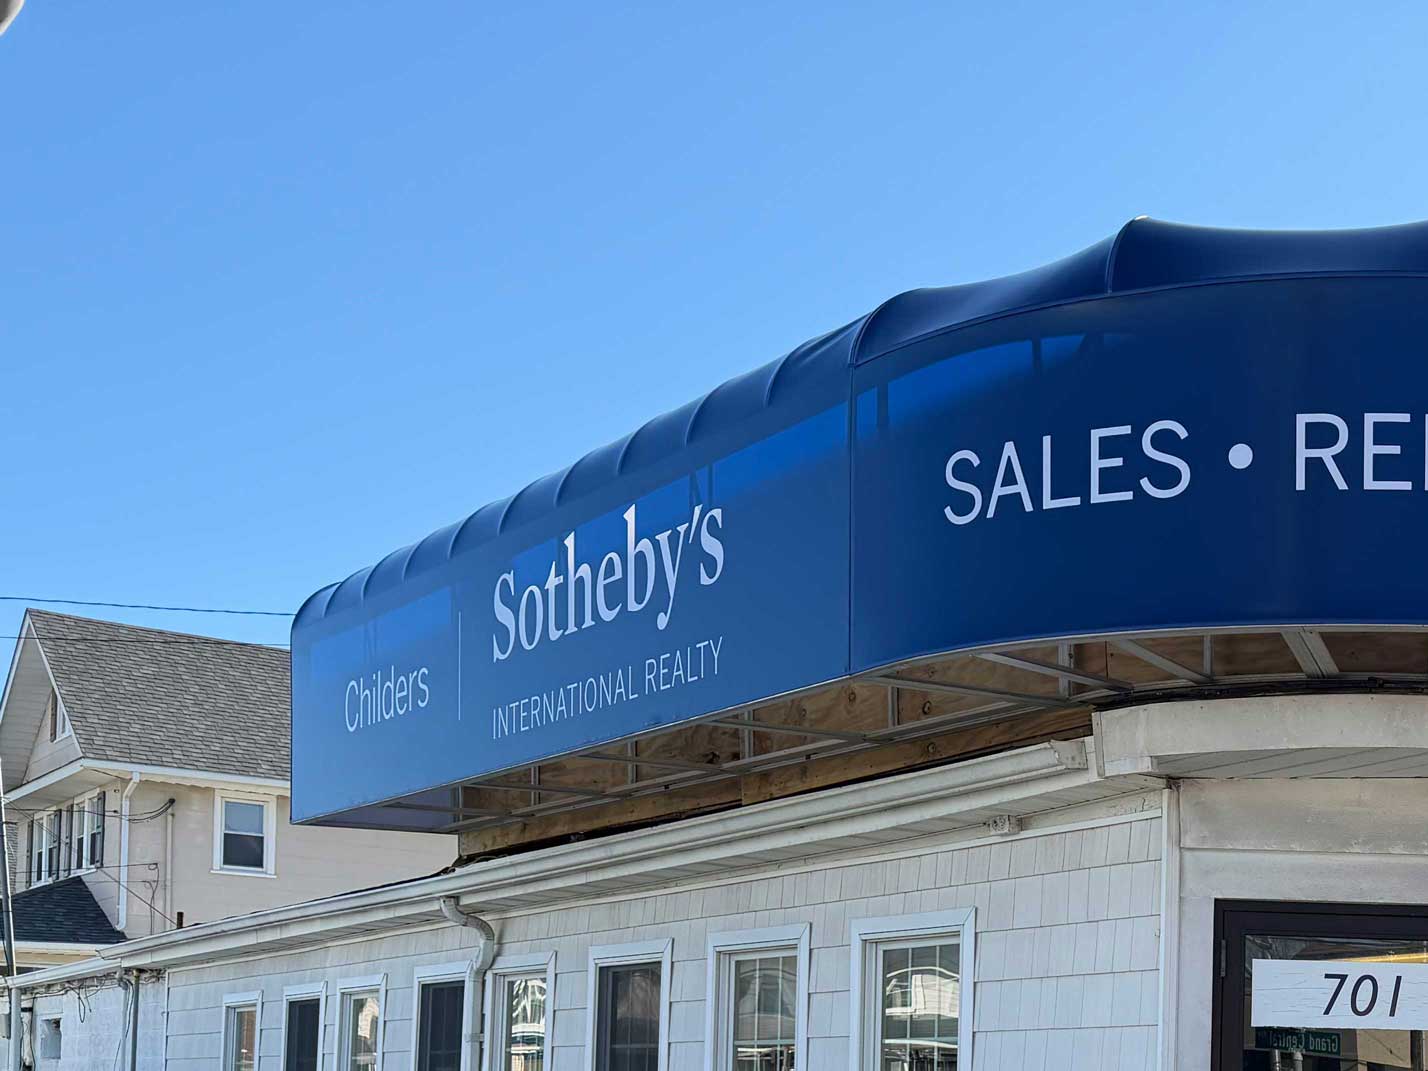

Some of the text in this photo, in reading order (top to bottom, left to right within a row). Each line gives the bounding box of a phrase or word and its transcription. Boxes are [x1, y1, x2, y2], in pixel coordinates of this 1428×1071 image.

[943, 418, 1192, 526] SALES
[492, 503, 725, 663] Sotheby's
[344, 664, 430, 734] Childers
[492, 635, 724, 740] INTERNATIONAL REALTY
[1322, 972, 1403, 1018] 701
